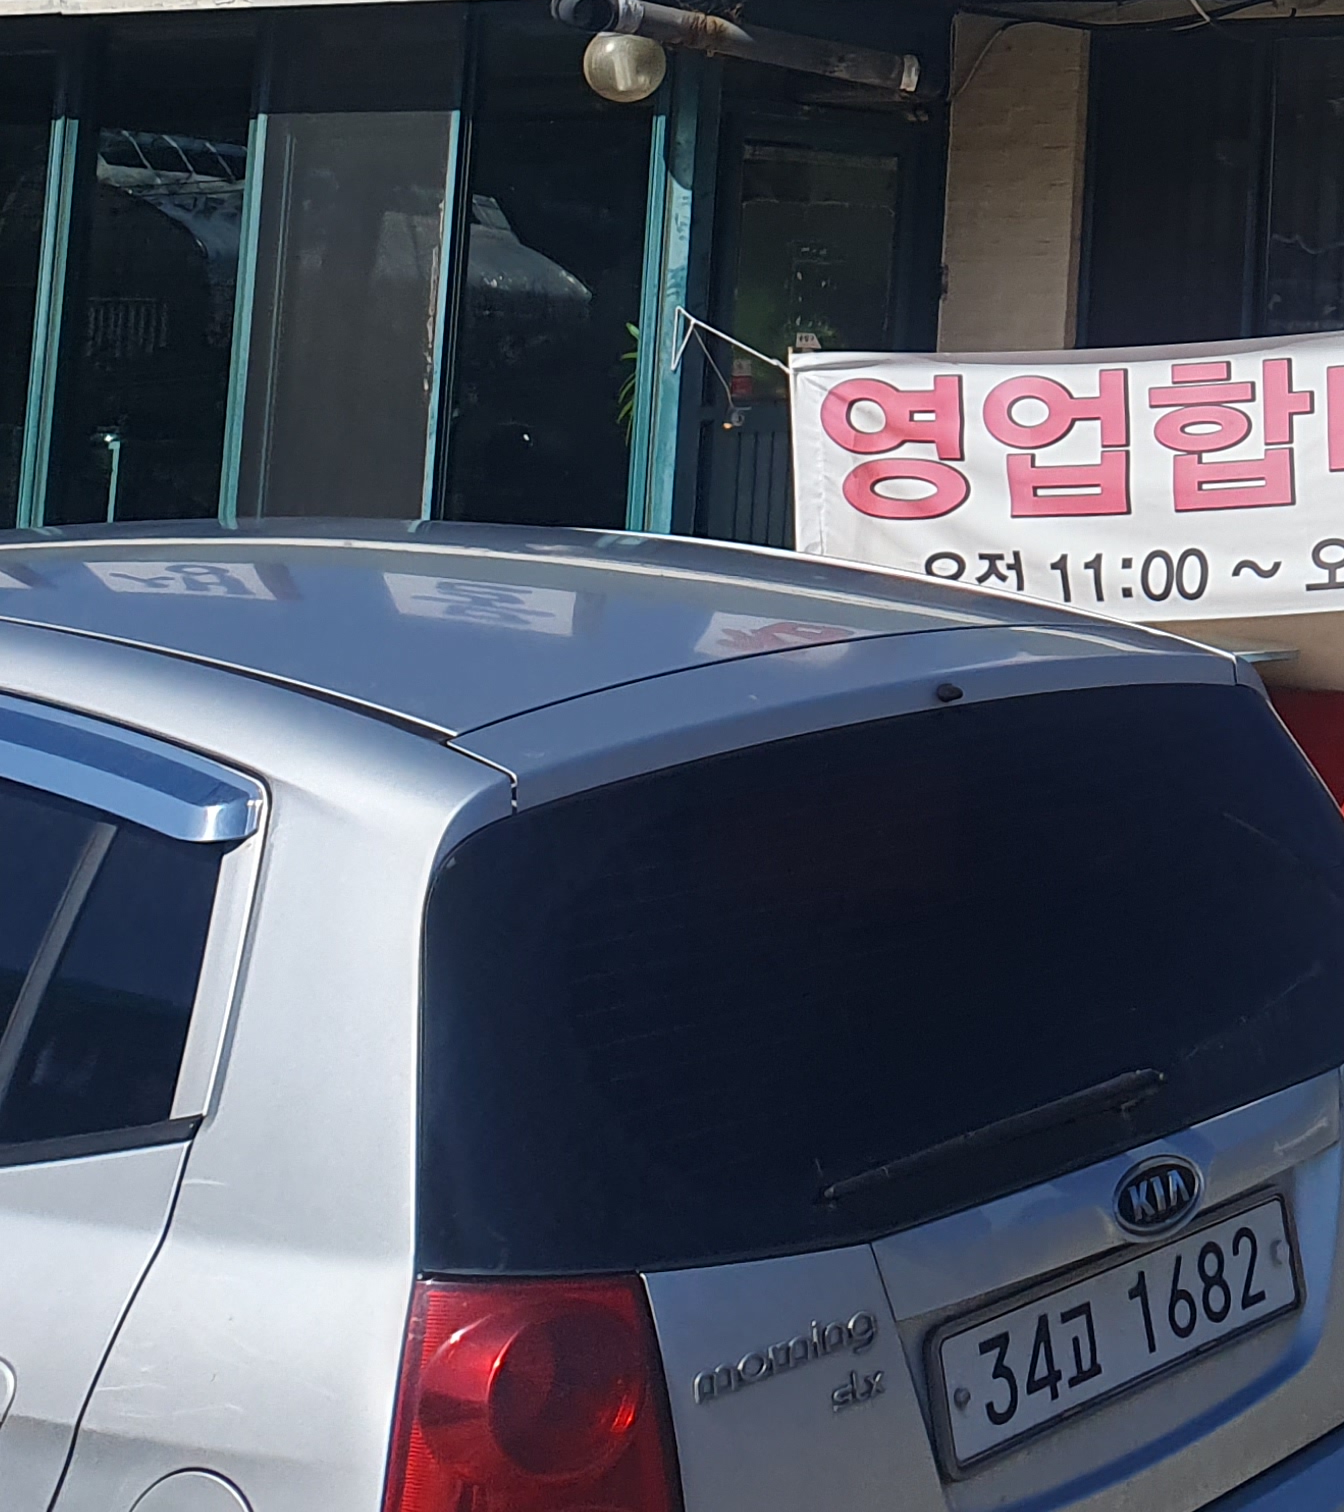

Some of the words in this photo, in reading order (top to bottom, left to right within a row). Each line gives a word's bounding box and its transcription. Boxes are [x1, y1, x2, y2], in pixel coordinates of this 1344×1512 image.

[1050, 547, 1210, 603] 11:00
[1129, 1169, 1191, 1222] KIA
[692, 1310, 877, 1405] morning
[978, 1300, 1103, 1426] 34고
[1128, 1226, 1267, 1354] 1682
